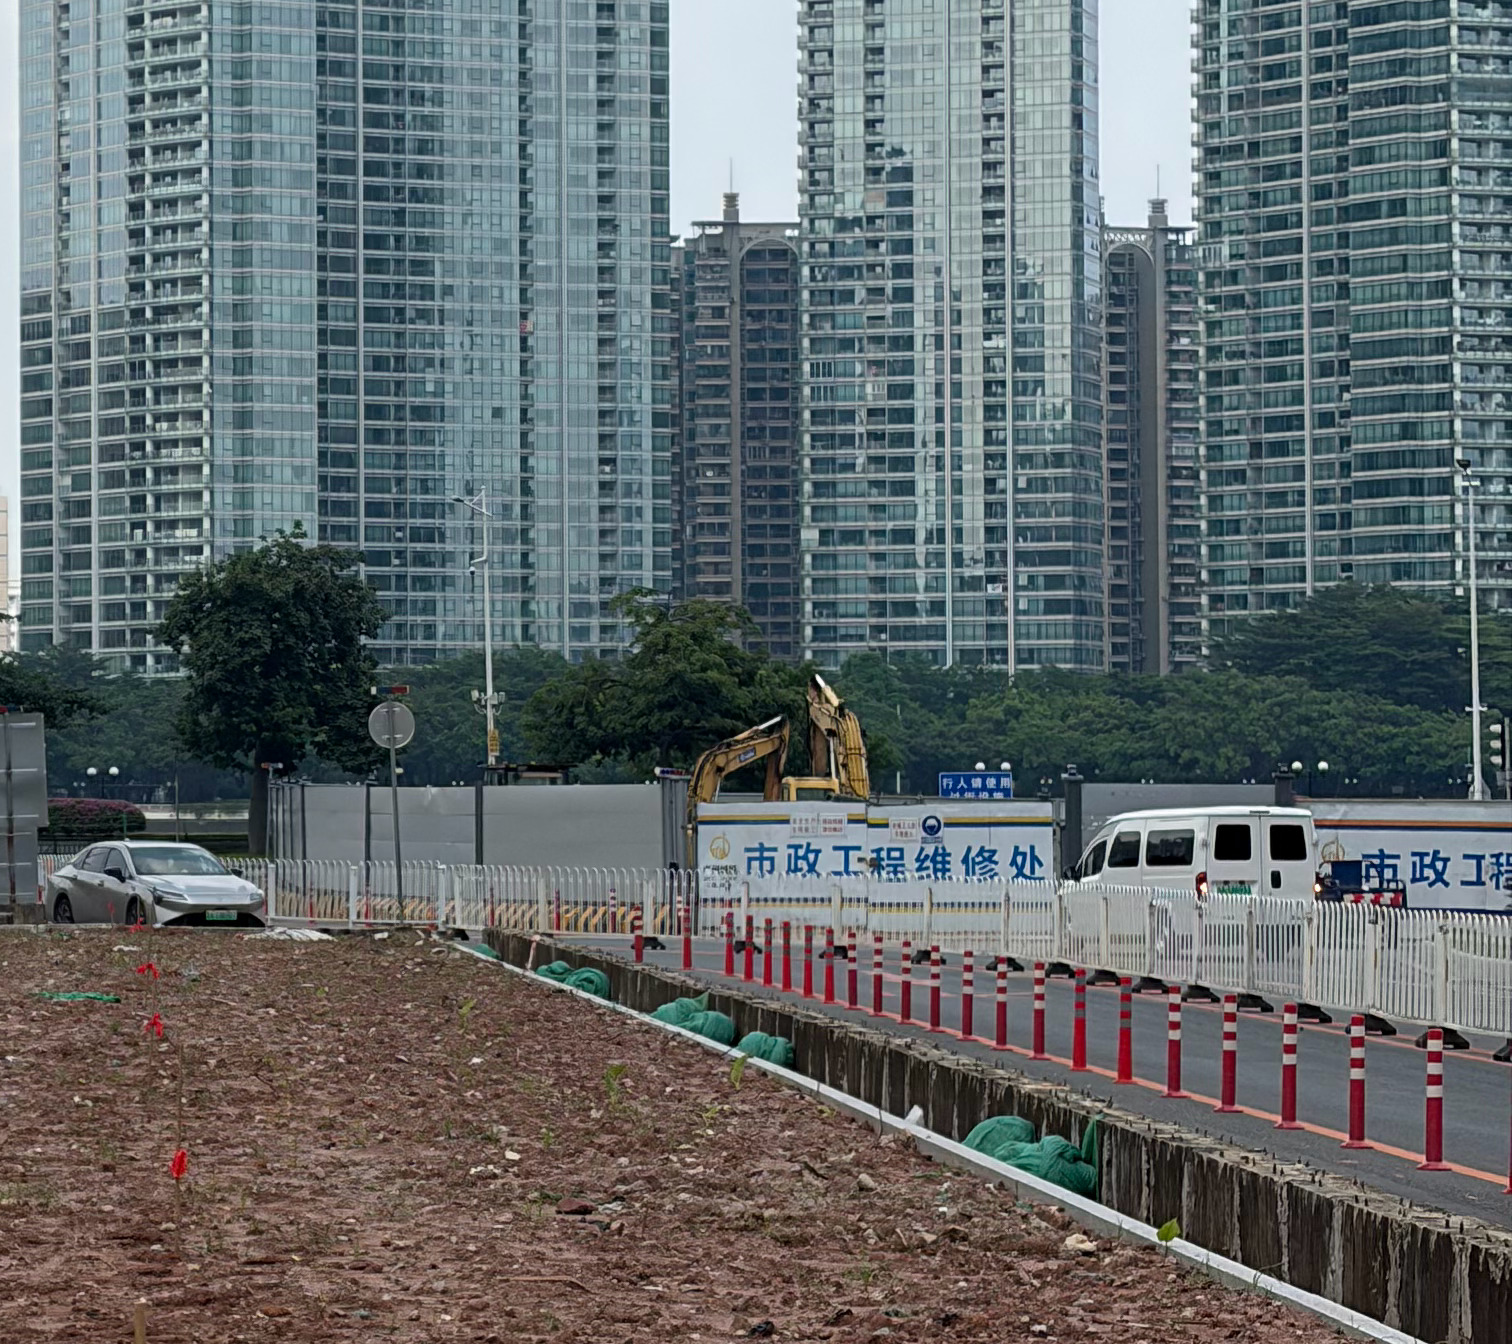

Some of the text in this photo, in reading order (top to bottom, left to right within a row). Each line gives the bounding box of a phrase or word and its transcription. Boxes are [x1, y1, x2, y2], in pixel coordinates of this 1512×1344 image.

[743, 841, 1046, 884] 市政工程维修处
